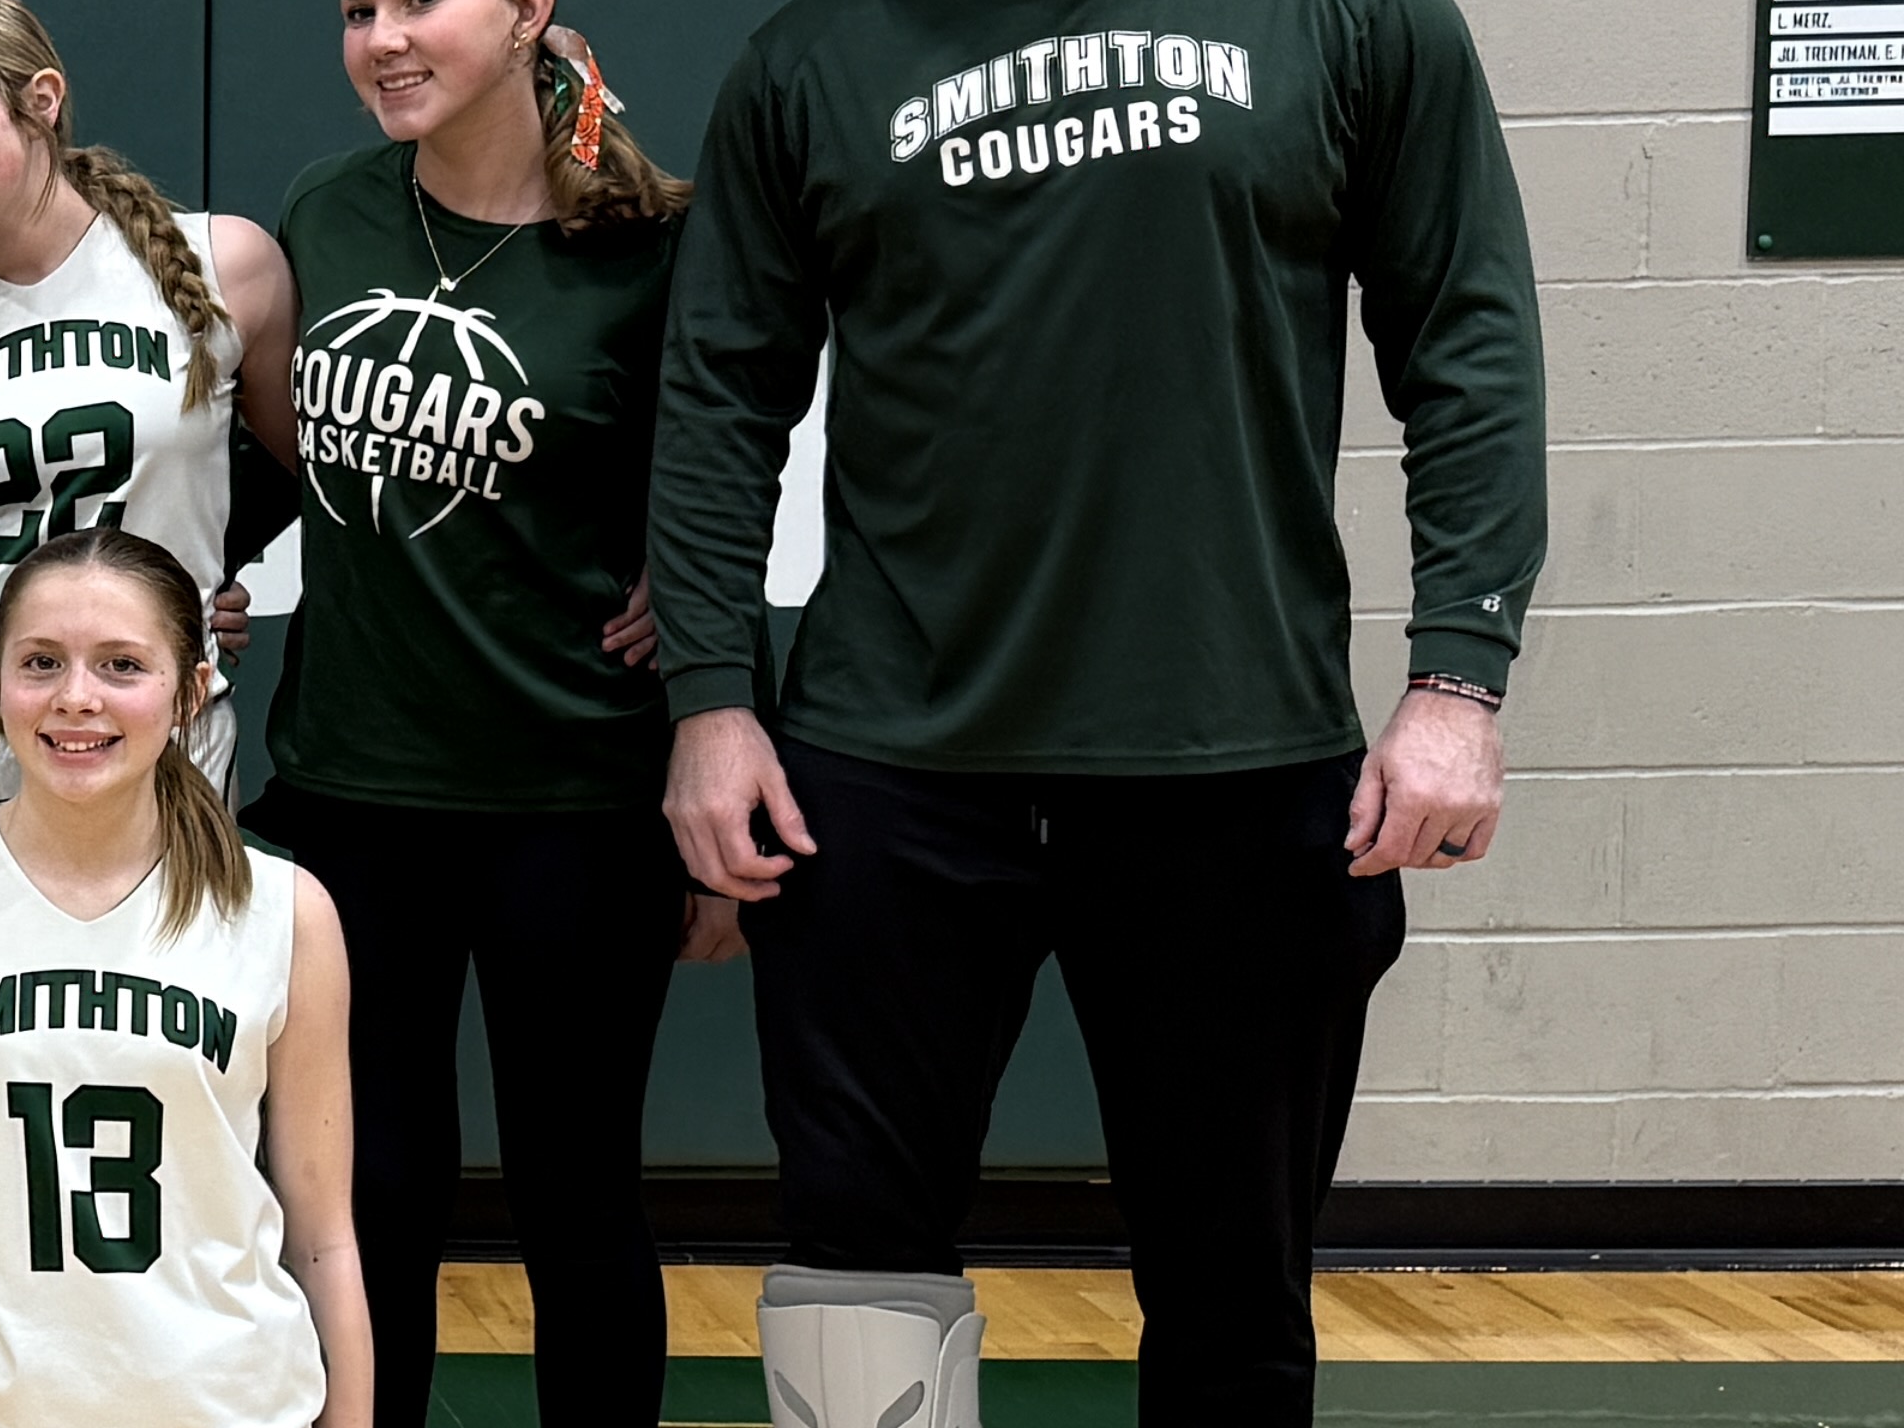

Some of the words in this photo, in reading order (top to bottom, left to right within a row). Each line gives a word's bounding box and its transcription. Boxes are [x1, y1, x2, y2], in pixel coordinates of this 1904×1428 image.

[891, 30, 1252, 162] SMITHTON
[939, 95, 1201, 187] COUGARS
[6, 1081, 164, 1274] 13
